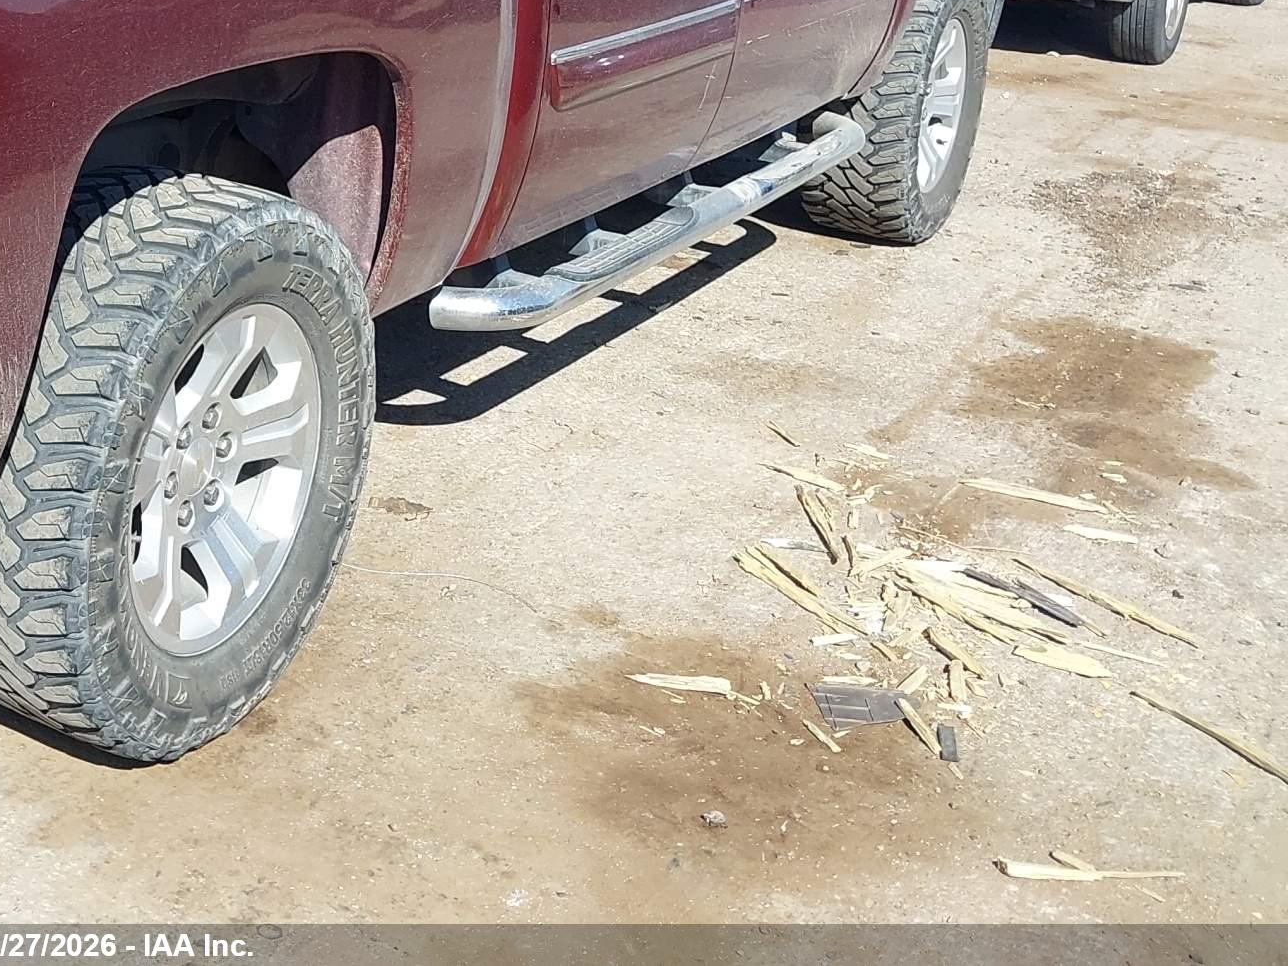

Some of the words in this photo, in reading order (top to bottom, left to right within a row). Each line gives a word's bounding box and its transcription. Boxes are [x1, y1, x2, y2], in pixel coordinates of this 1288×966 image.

[281, 264, 341, 326] TERRA
[328, 318, 361, 447] HUNTER
[321, 456, 354, 523] M/T
